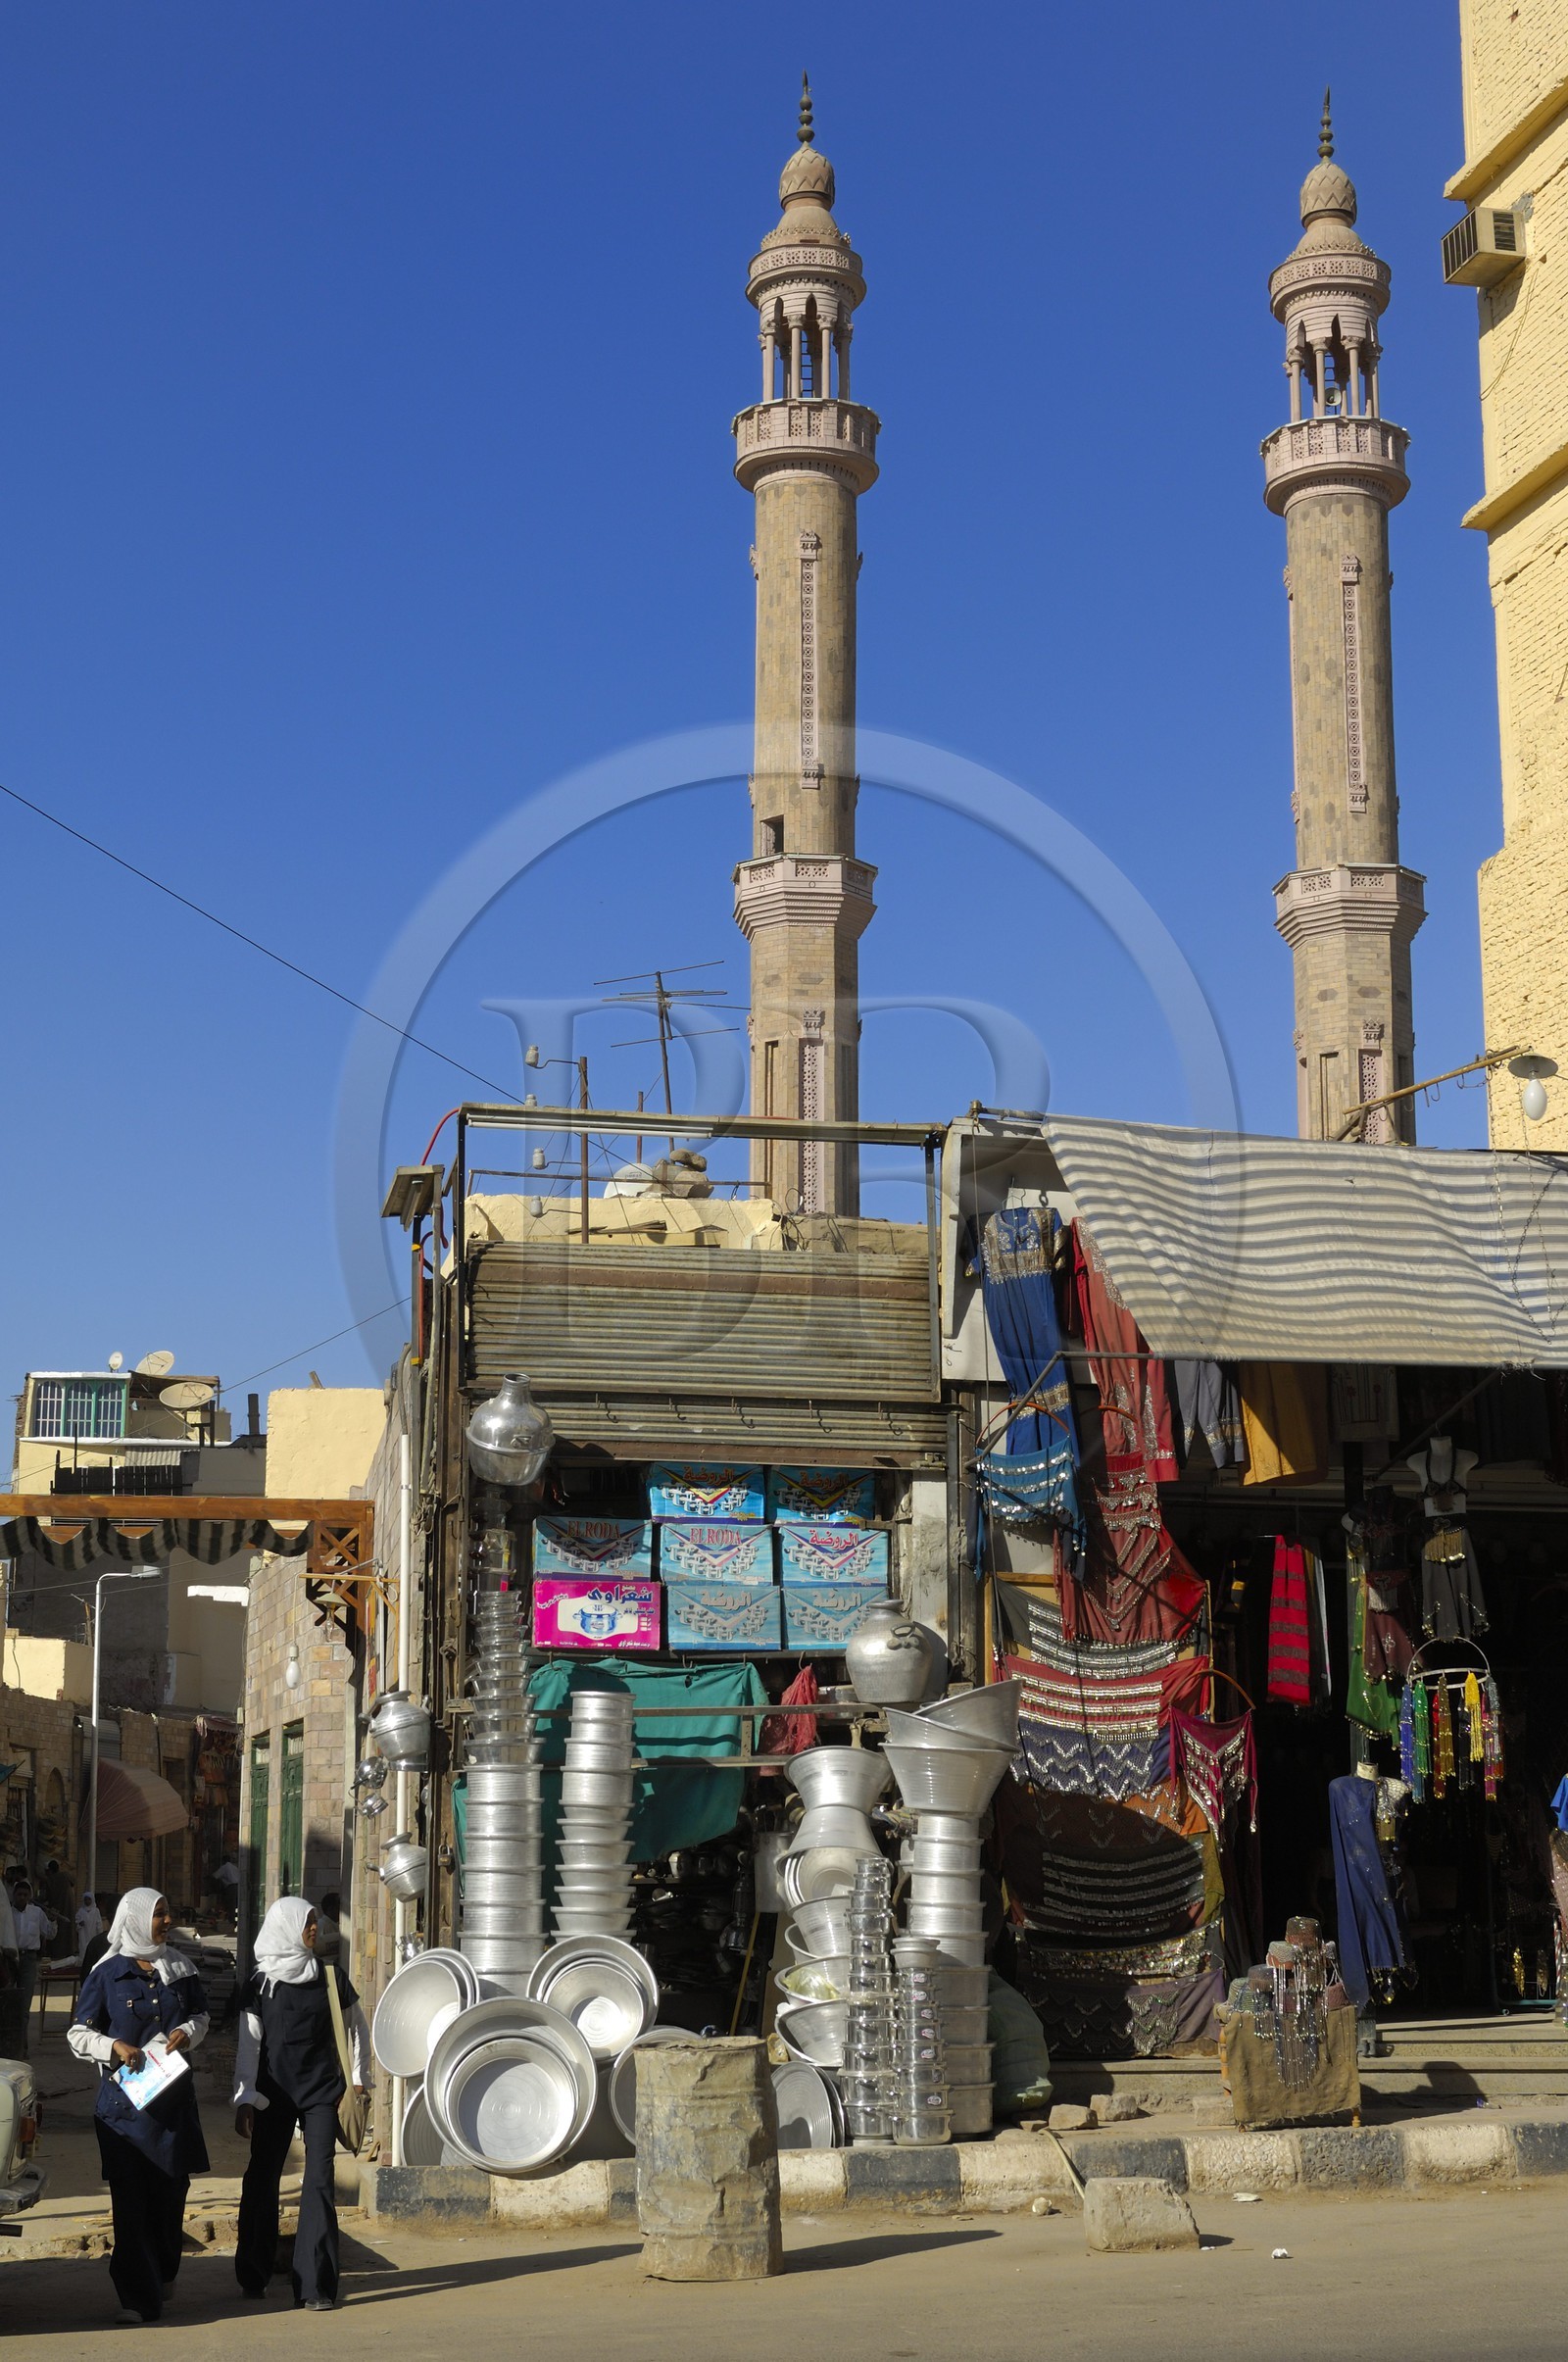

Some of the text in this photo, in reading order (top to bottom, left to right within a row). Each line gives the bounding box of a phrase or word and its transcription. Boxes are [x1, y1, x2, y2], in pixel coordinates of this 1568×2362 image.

[808, 1529, 859, 1550] الروضة
[700, 1590, 753, 1611] الروضة
[812, 1591, 862, 1611] الروضة
